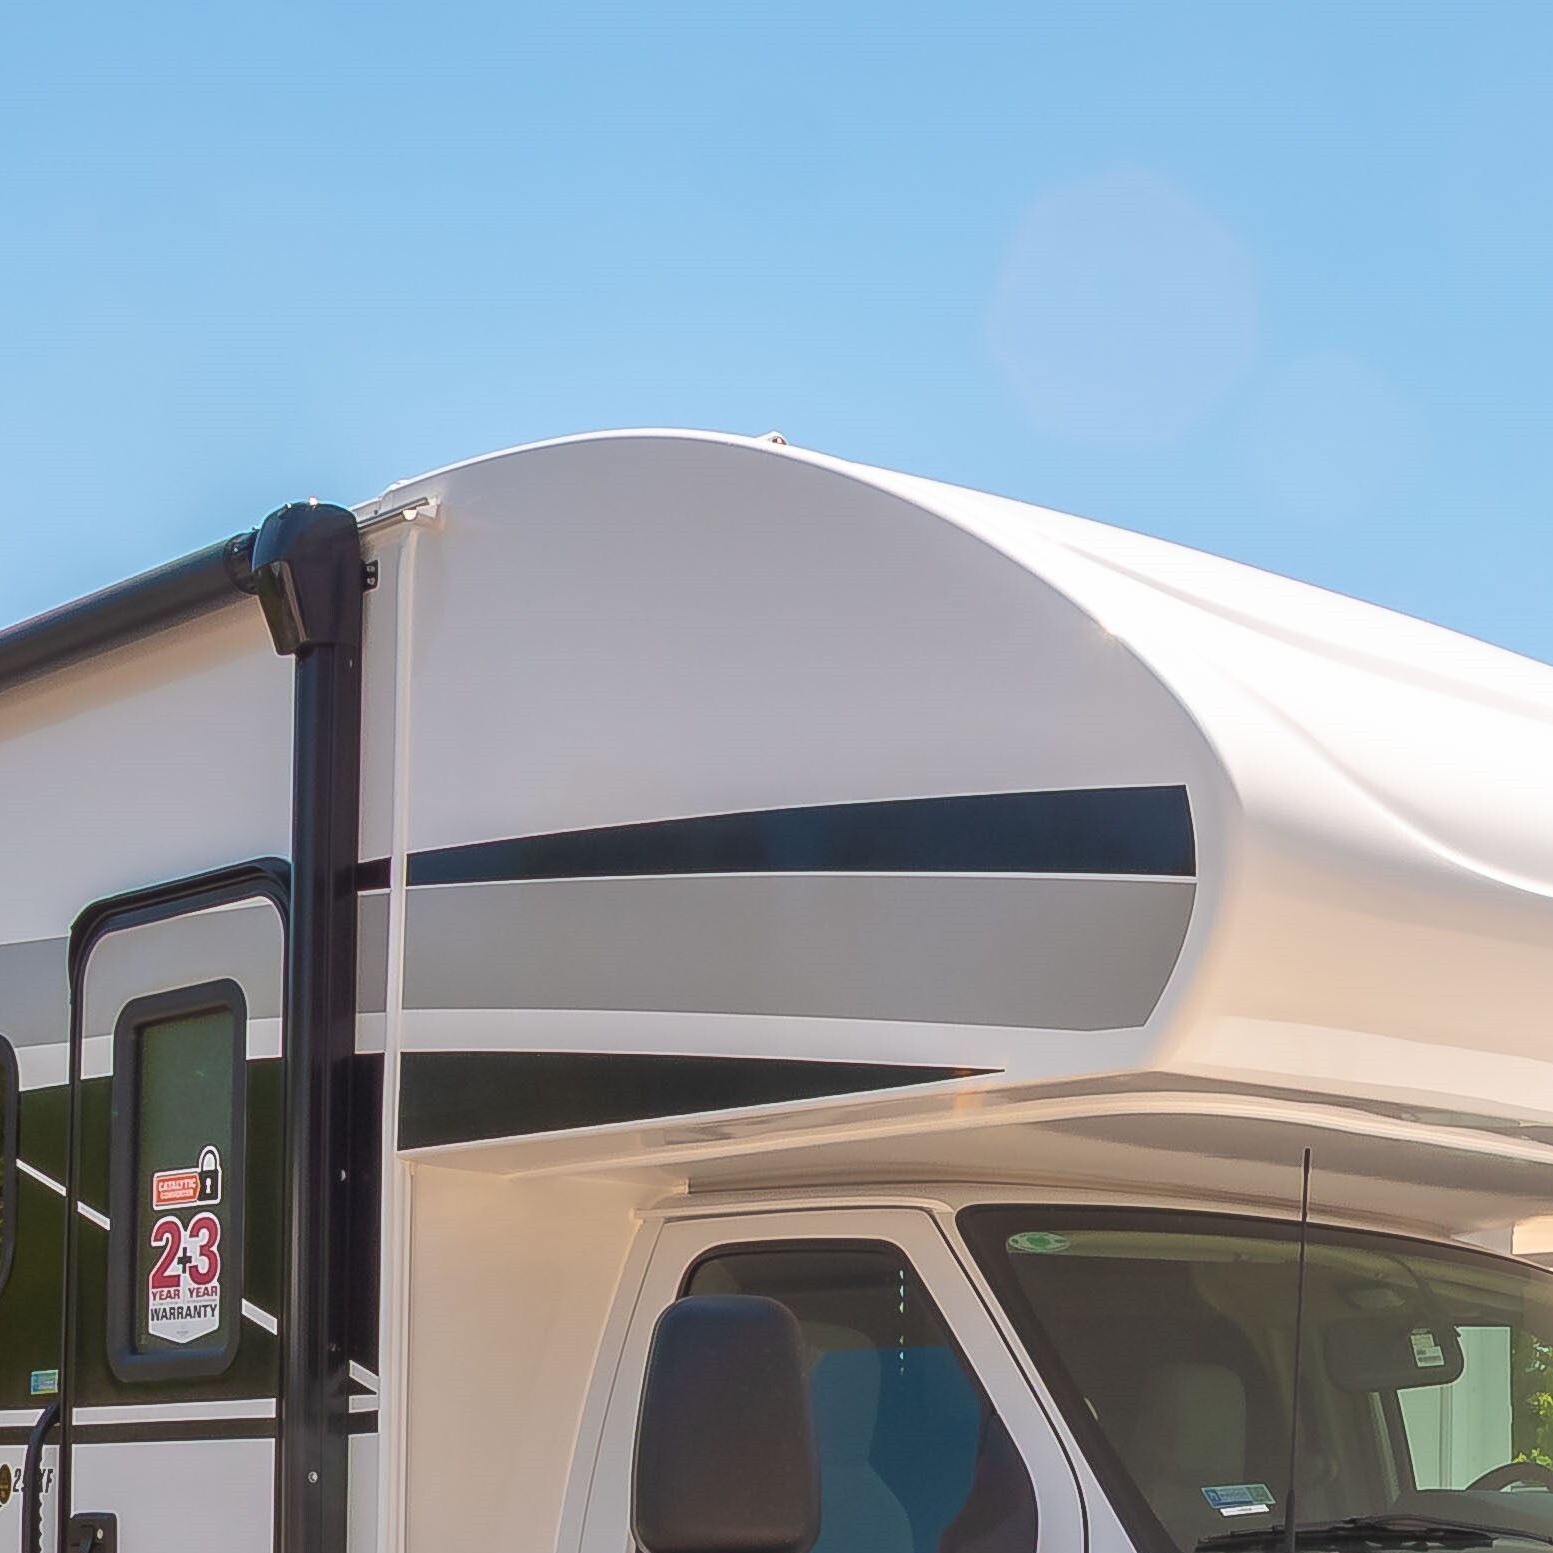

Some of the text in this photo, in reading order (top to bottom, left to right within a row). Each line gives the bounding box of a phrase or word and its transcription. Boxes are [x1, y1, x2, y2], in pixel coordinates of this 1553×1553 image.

[151, 1285, 218, 1301] YEAR YEAR
[150, 1303, 218, 1321] WARRANTY
